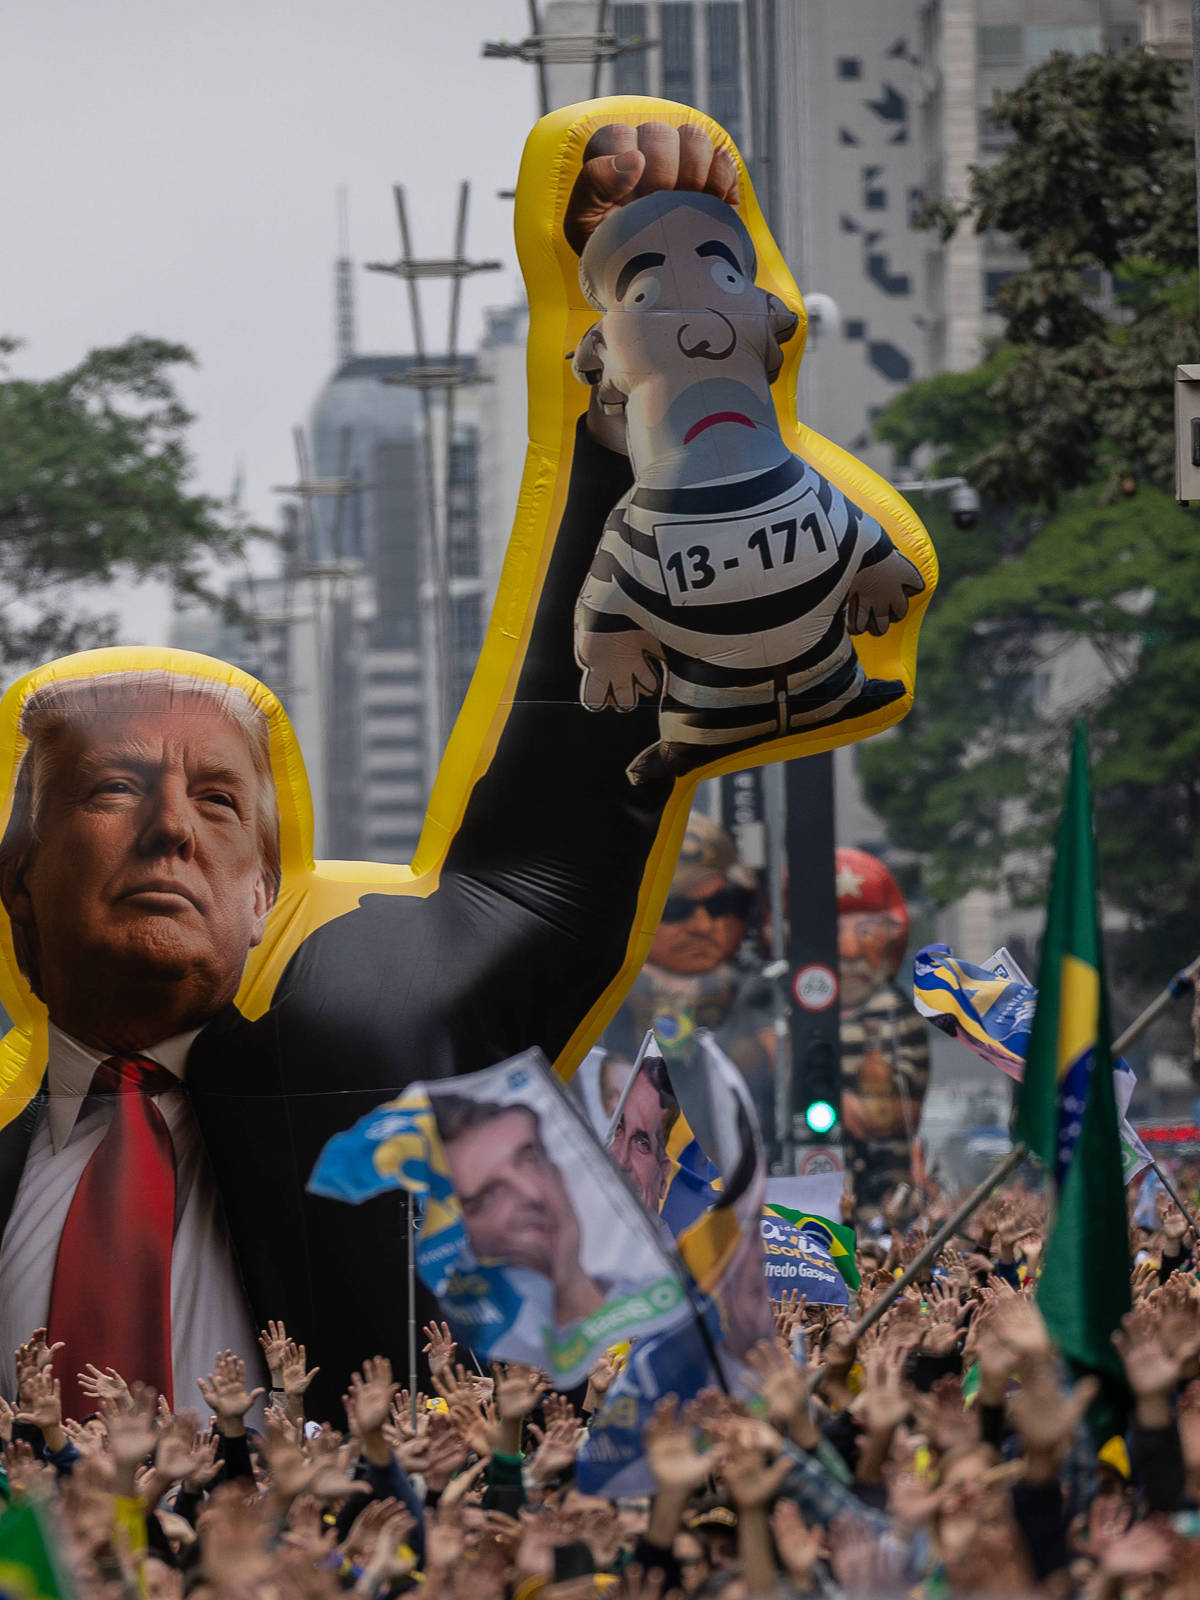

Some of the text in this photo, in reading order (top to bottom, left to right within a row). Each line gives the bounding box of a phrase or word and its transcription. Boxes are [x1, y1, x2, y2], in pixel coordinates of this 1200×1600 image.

[666, 545, 716, 593] 13
[748, 512, 827, 570] 171
[764, 1262, 797, 1278] fredo
